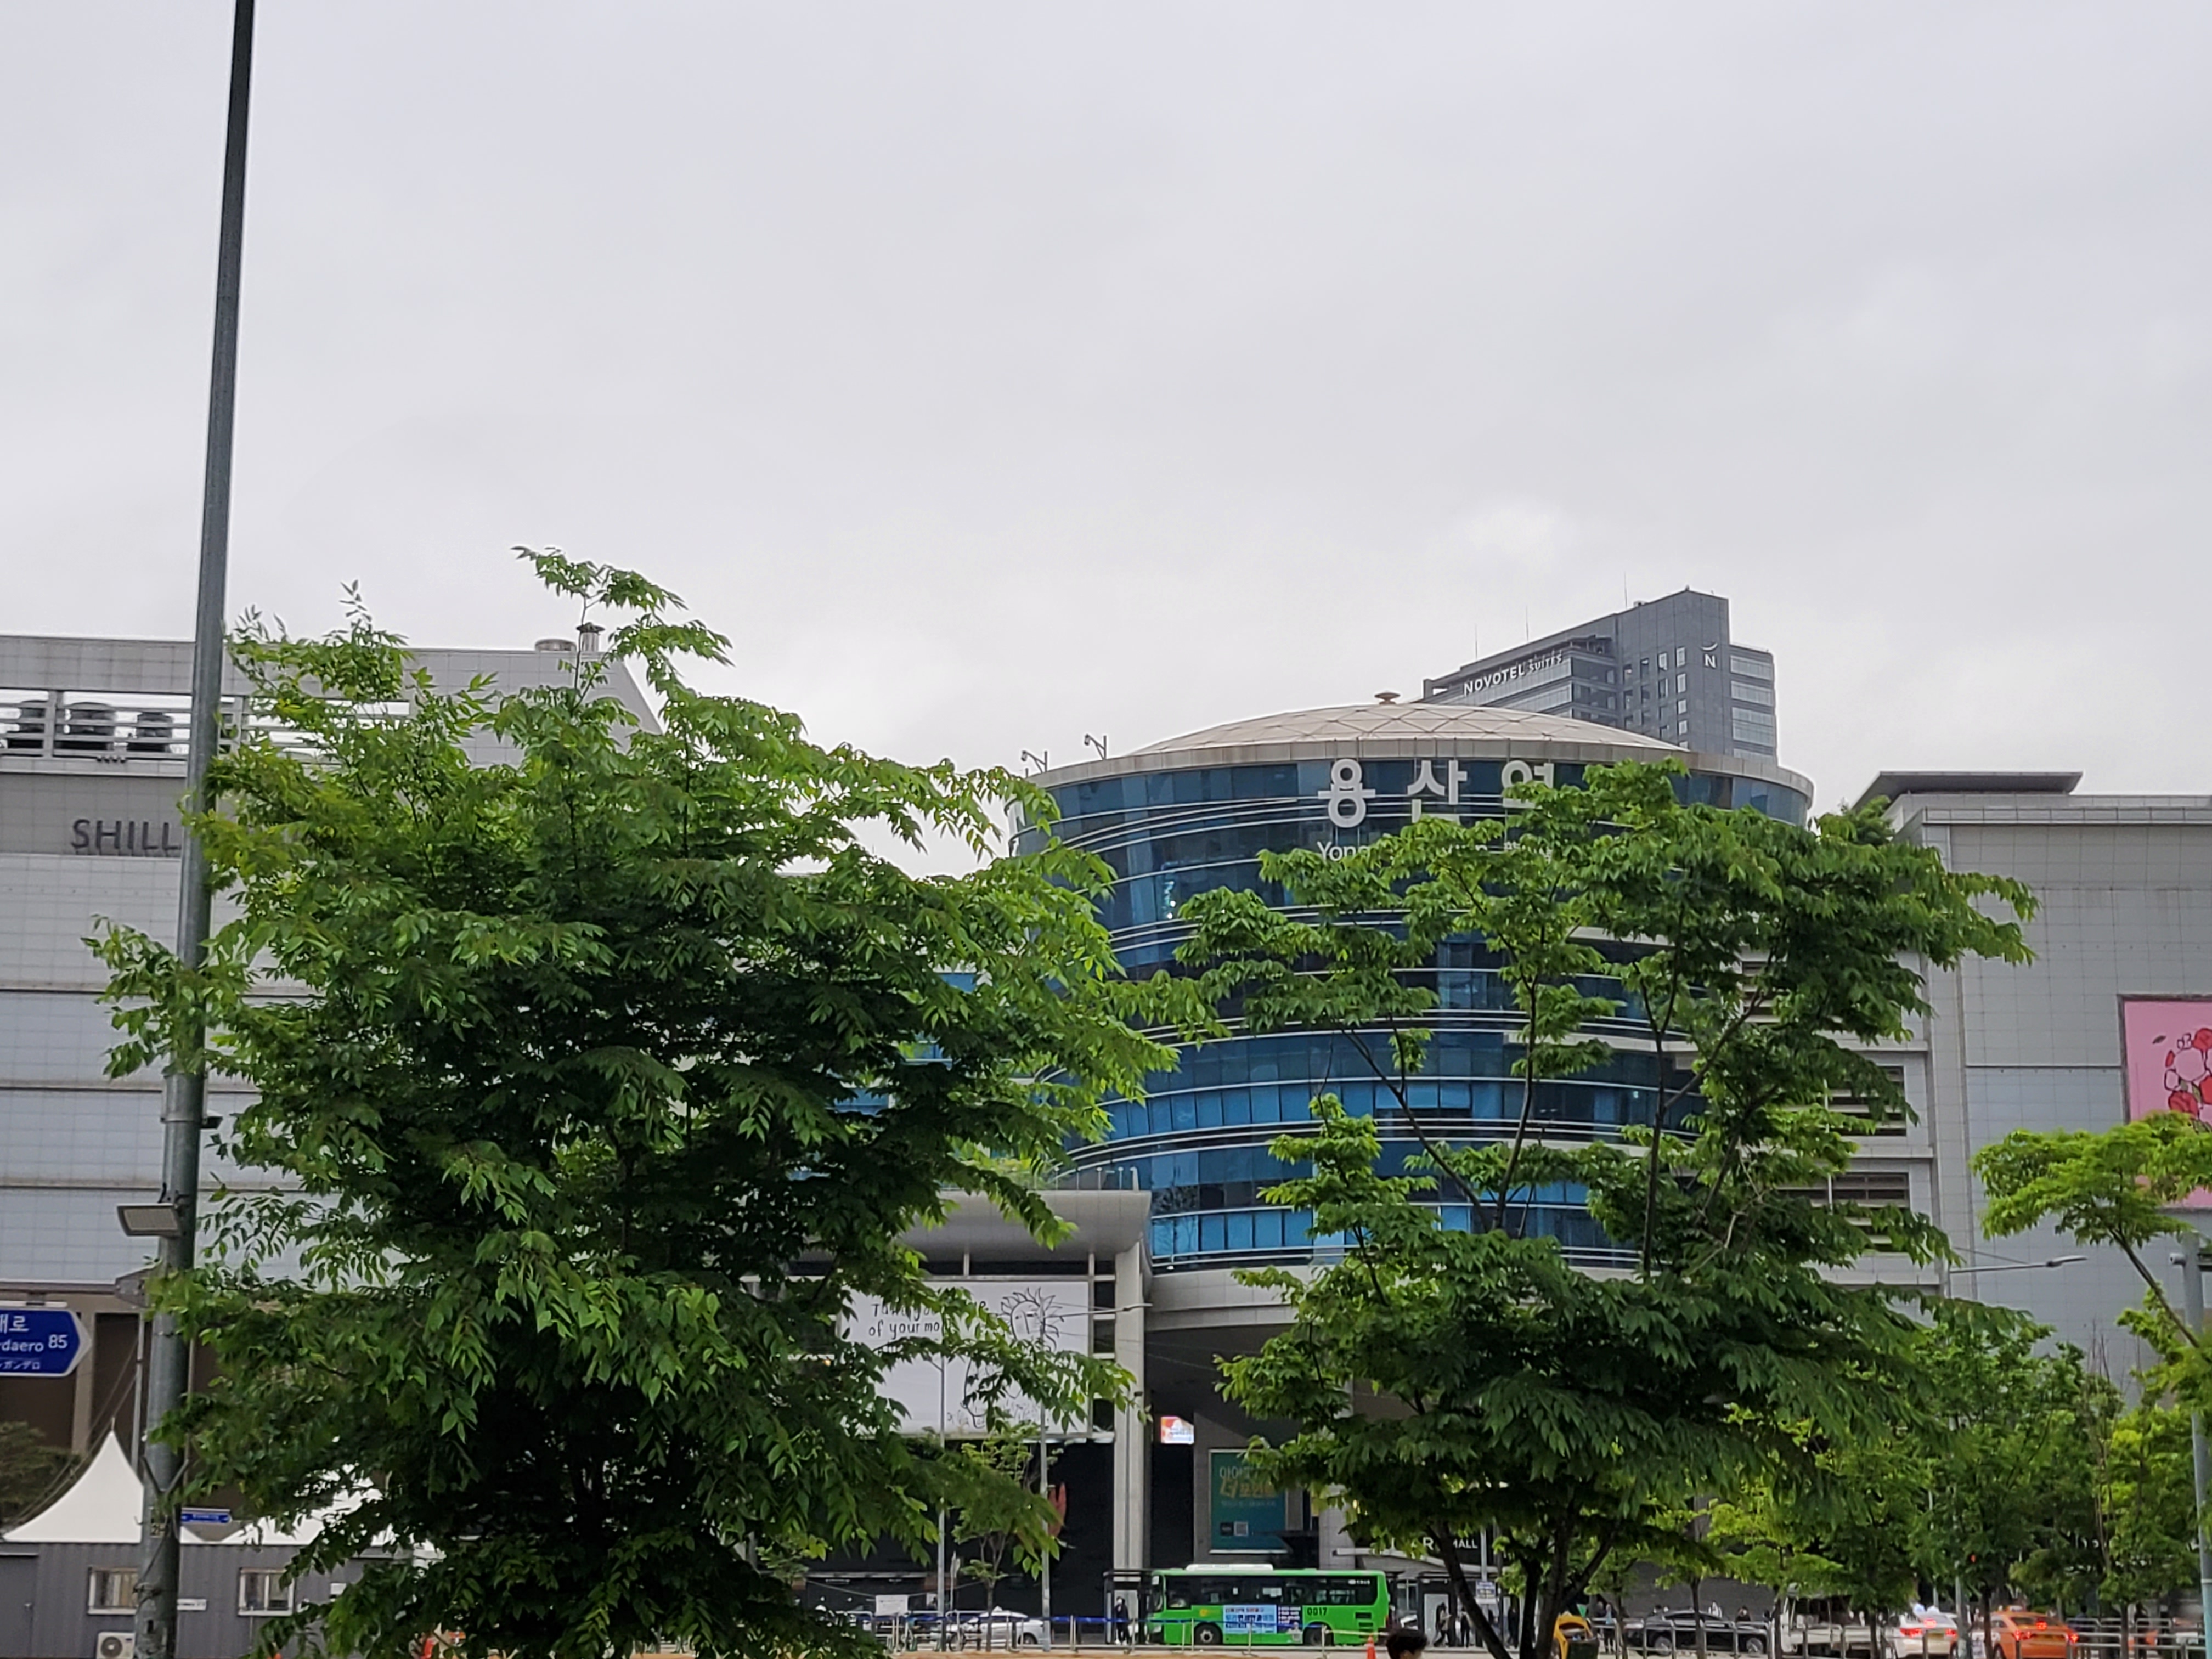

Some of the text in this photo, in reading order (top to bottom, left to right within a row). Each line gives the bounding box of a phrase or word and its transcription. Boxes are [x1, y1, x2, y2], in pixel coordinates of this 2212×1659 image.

[1705, 654, 1716, 668] N
[1463, 664, 1525, 696] NOVOTEL
[70, 819, 182, 850] SHILL
[868, 1319, 940, 1340] of your mo
[48, 1334, 68, 1348] 85
[1307, 1607, 1328, 1616] 0017
